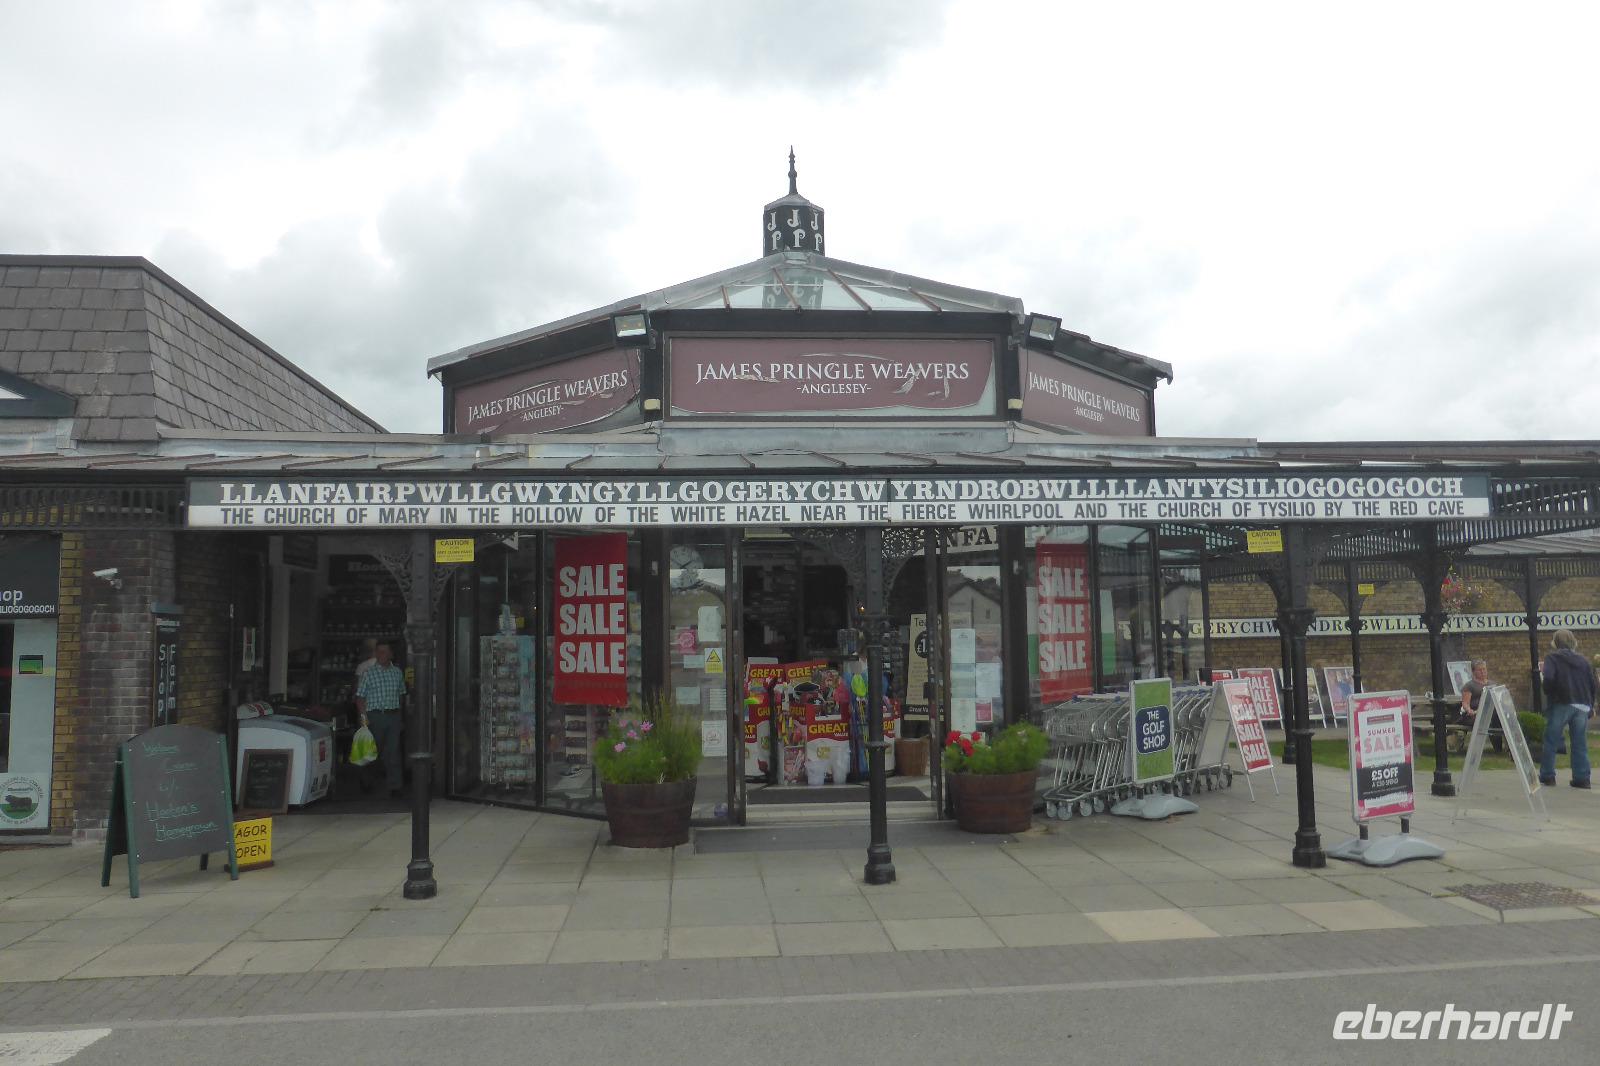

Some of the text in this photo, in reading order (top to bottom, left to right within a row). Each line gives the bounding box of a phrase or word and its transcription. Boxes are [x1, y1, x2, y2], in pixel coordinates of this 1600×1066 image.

[695, 362, 970, 384] JAMES PRINGLE WEAVERS
[468, 370, 628, 425] JAMES PRINGLE WEAVERS
[1028, 372, 1140, 422] JAMES PRINGLE WEAVERS
[220, 499, 1464, 524] THE CHURCH OF MARY IN THE HOLLOW OF THE WHITE HAZEL NEAR THE FIERCE WHIRLPOOL AND THE CHURCH OF TYSILIO BY THE RED CAVE
[559, 563, 625, 598] SALE
[1039, 565, 1085, 598] SALE
[0, 590, 23, 606] op
[559, 602, 626, 636] SALE
[1038, 603, 1085, 634] SALE
[559, 641, 625, 674] SALE
[1039, 640, 1087, 673] SALE
[750, 668, 783, 678] GREAT
[1254, 689, 1273, 702] ALE
[1147, 710, 1160, 720] THE
[1256, 702, 1276, 715] ALE
[808, 723, 848, 734] GREAT
[1142, 721, 1165, 735] GOLF
[1237, 723, 1263, 742] SALE
[1367, 727, 1396, 736] SUMMER
[1143, 735, 1166, 750] SHOP
[1365, 735, 1401, 753] SALE
[1242, 743, 1268, 762] SALE
[1371, 766, 1399, 781] £5 OFF
[235, 824, 267, 838] AGOR
[236, 845, 266, 858] OPEN
